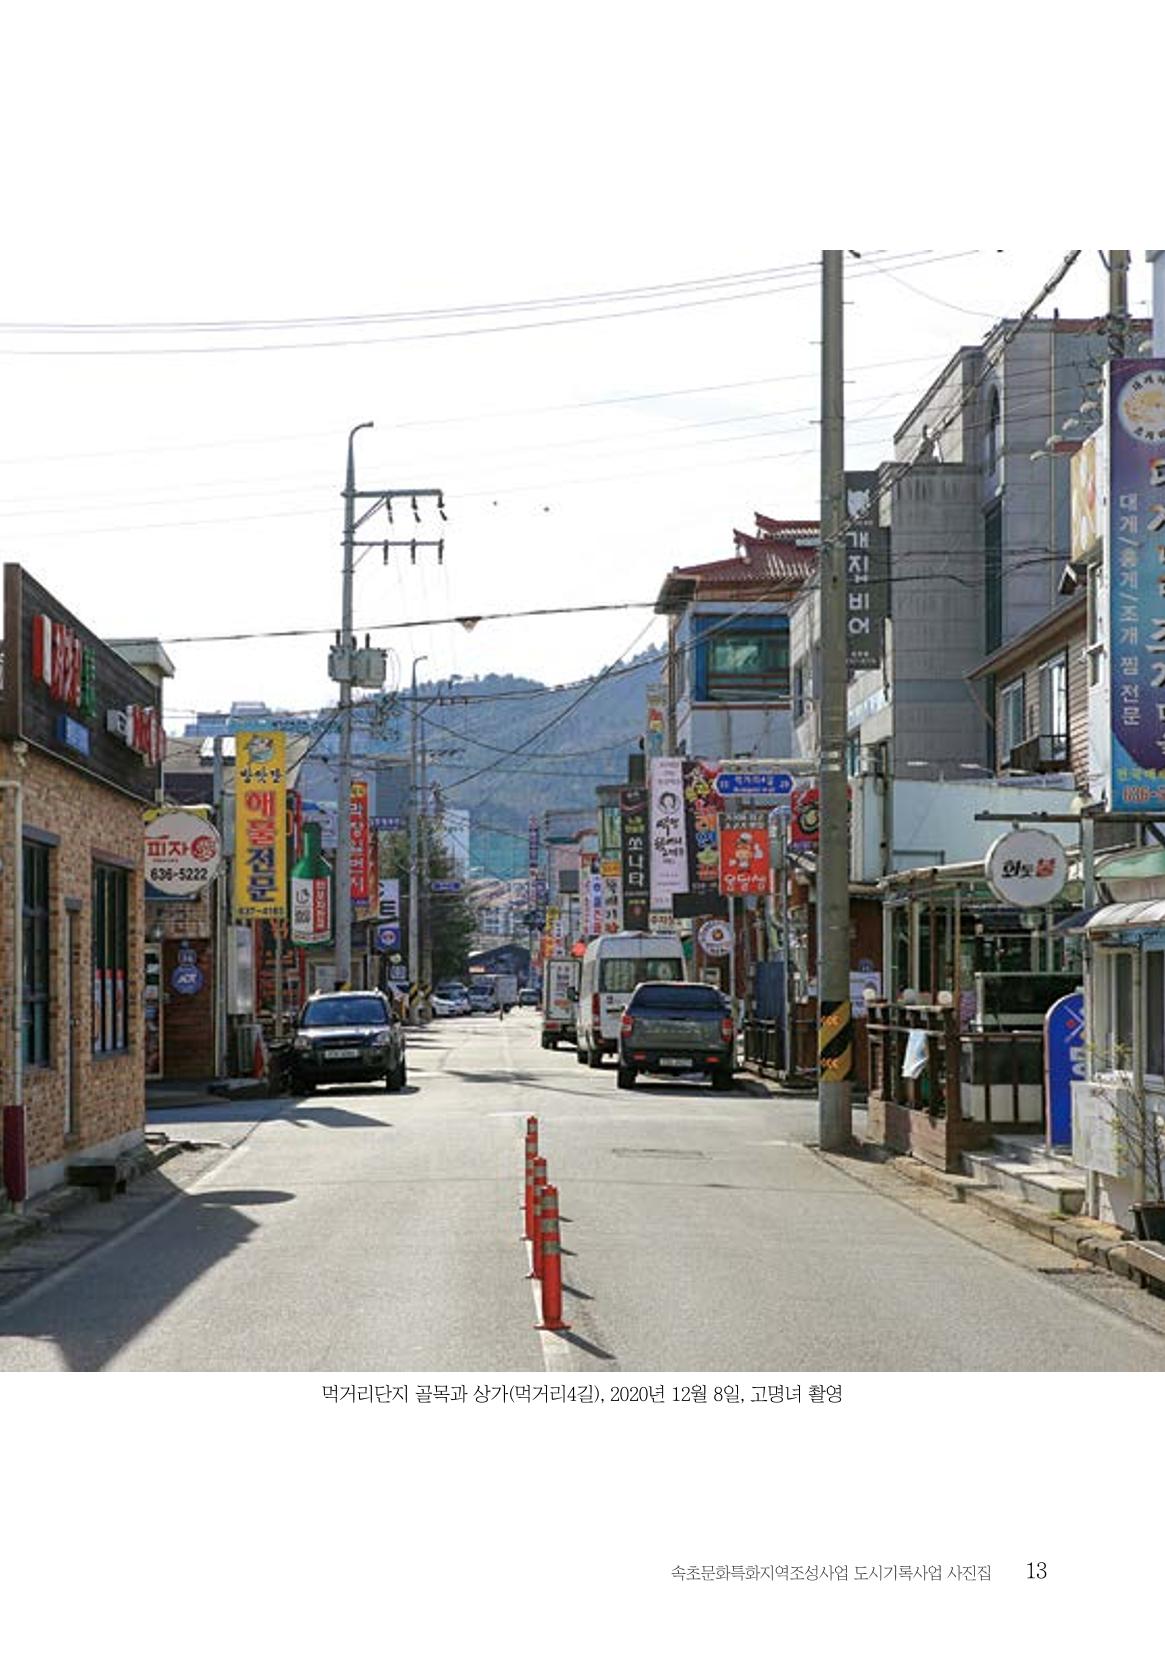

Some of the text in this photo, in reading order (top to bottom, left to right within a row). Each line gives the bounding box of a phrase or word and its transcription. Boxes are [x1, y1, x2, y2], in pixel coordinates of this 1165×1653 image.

[847, 531, 870, 634] 개집비어
[1120, 656, 1139, 676] 찜
[1120, 684, 1141, 726] 전문
[147, 834, 188, 856] 피자
[150, 867, 208, 881] 636-5222
